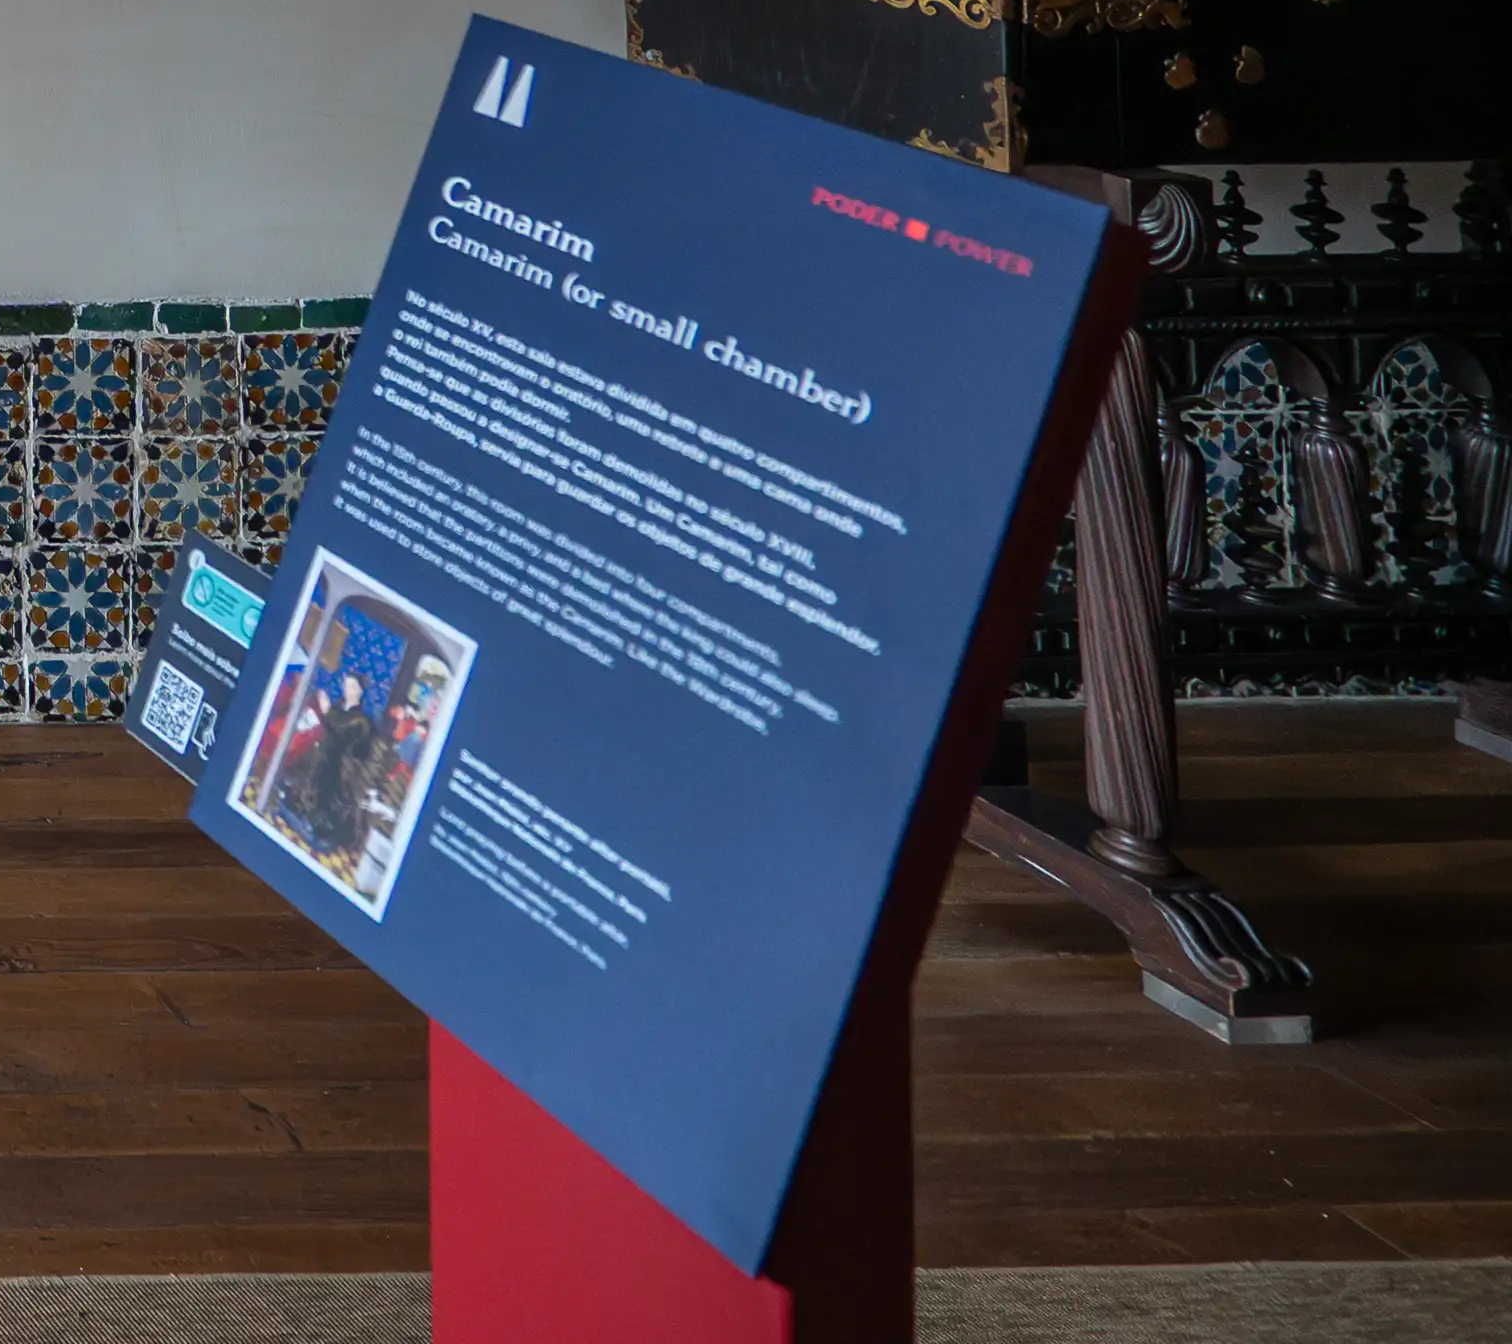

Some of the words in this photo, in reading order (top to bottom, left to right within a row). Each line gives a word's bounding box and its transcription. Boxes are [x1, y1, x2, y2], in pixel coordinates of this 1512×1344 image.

[441, 176, 594, 262] Camarim
[811, 186, 900, 232] PODER
[933, 229, 1034, 277] POWER
[392, 328, 404, 340] o
[403, 333, 424, 350] rei
[422, 341, 479, 377] também
[476, 369, 520, 397] podia
[518, 389, 570, 423] dormir.
[405, 289, 427, 307] No
[554, 360, 606, 391] estava
[605, 383, 669, 421] dividida
[667, 413, 698, 434] em
[696, 425, 756, 460] quatro
[428, 215, 553, 289] Camarim
[561, 273, 605, 308] (or
[608, 300, 698, 349] small
[703, 336, 871, 424] chamber)
[372, 382, 384, 396] a
[383, 387, 478, 447] Guarda-Roupa,
[477, 438, 522, 468] servia
[519, 460, 557, 486] para
[555, 478, 616, 515] guardar
[615, 509, 637, 527] os
[635, 520, 699, 559] objetos
[696, 552, 723, 572] de
[721, 564, 786, 605] grande
[379, 365, 429, 397] quando
[428, 390, 477, 421] passou
[474, 414, 488, 427] a
[487, 420, 570, 469] designar-se
[569, 459, 642, 507] Camarim.
[644, 497, 675, 522] Um
[756, 554, 784, 577] tal
[782, 569, 837, 605] como
[385, 344, 443, 382] Pensa-se
[442, 375, 472, 396] que
[556, 428, 602, 461] foram
[600, 453, 683, 502] demolidas
[682, 493, 709, 513] no
[398, 309, 434, 333] onde
[433, 325, 451, 341] se
[449, 334, 539, 383] encontravam
[537, 375, 552, 388] o
[614, 412, 652, 436] uma
[721, 462, 763, 489] uma
[761, 481, 813, 514] cama
[811, 505, 862, 538] onde
